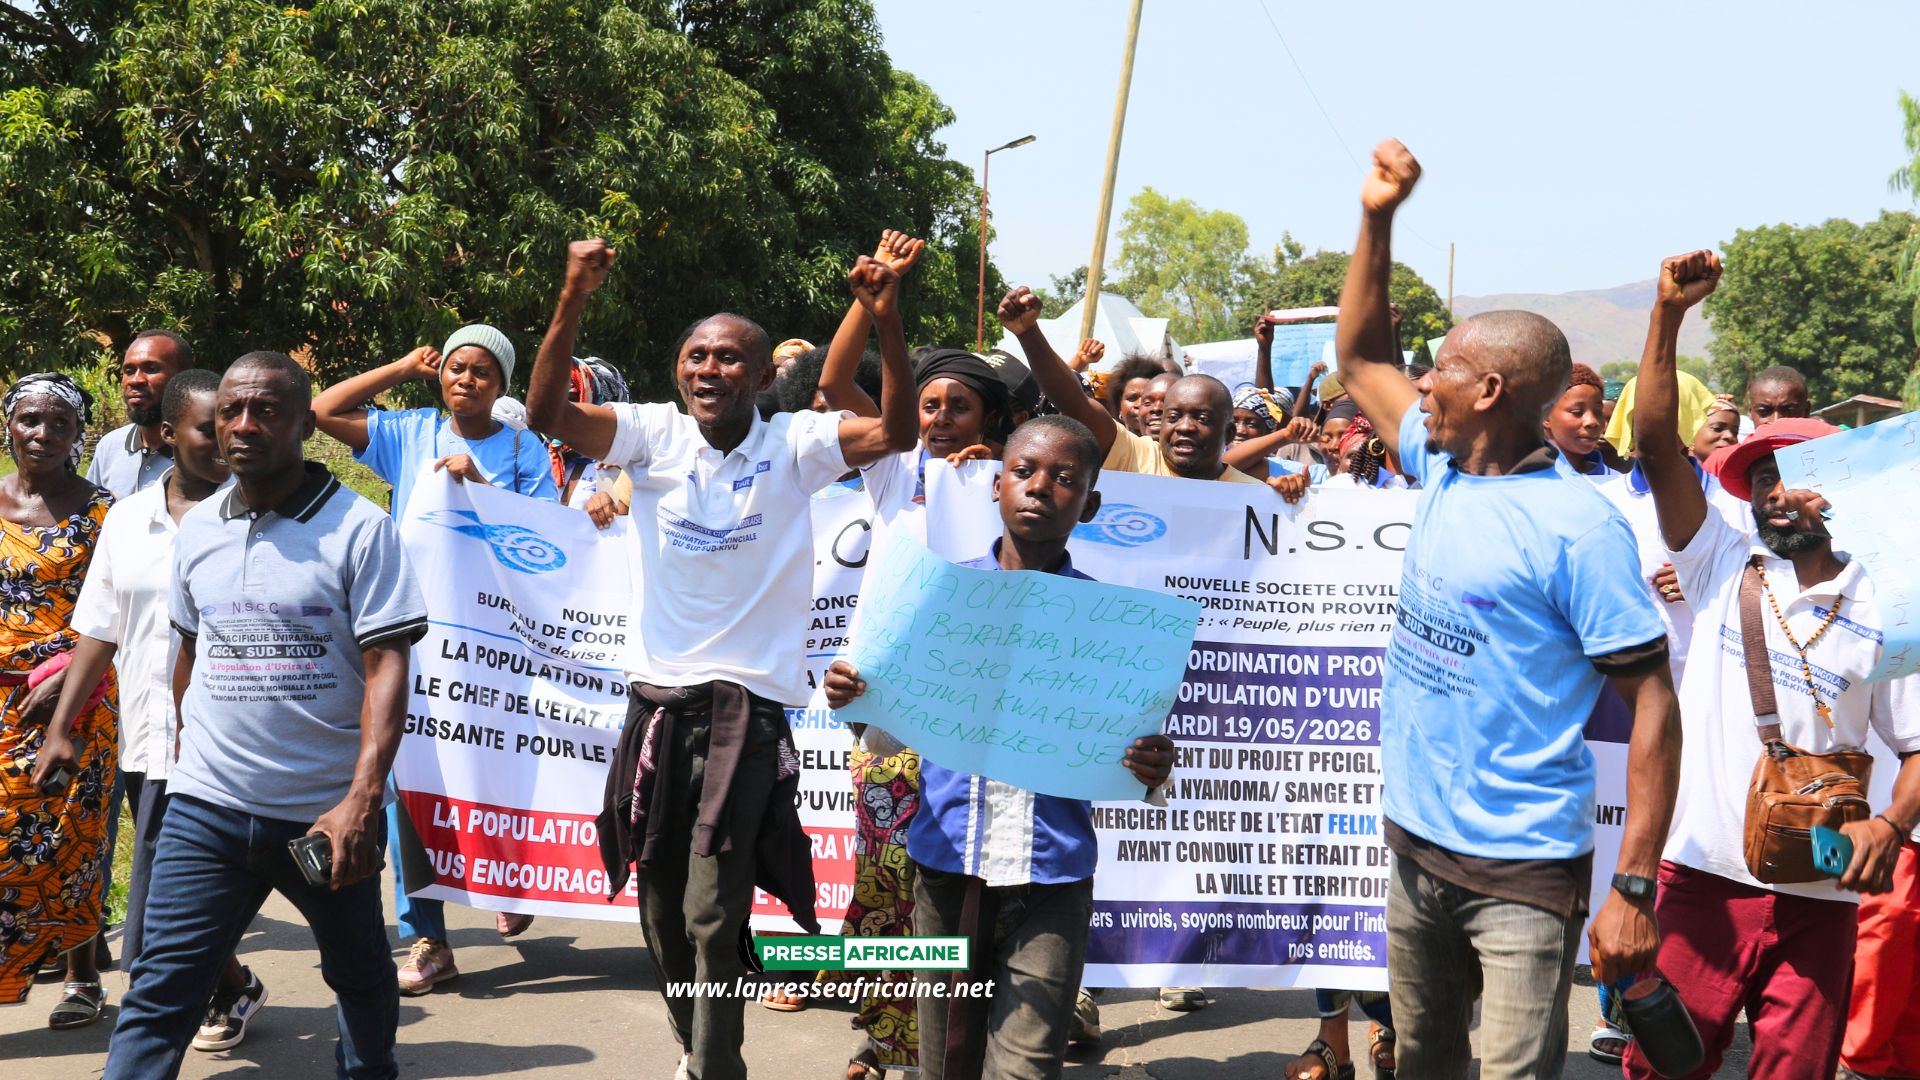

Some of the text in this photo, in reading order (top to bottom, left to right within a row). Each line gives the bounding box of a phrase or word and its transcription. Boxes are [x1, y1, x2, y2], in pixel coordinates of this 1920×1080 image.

[672, 539, 684, 547] DU
[1165, 575, 1250, 593] NOUVELLE
[1256, 582, 1336, 596] SOCIETE
[810, 594, 859, 611] ONG
[966, 576, 1075, 623] OMBA
[1177, 594, 1314, 614] ORDINATION
[477, 591, 536, 630] BUREAU
[542, 623, 566, 640] DE
[1233, 617, 1291, 633] Peuple,
[1297, 620, 1335, 633] plus
[1340, 620, 1375, 632] rien
[285, 646, 321, 657] KIVU
[509, 621, 547, 650] Notre
[551, 644, 606, 661] devise
[1430, 630, 1469, 654] KIVU
[270, 673, 280, 681] DU
[282, 673, 311, 681] PROJET
[305, 662, 318, 670] dit
[441, 639, 469, 662] LA
[475, 645, 603, 693] POPULATION
[924, 649, 1011, 680] SOKO
[1018, 665, 1098, 696] KAMA
[238, 684, 265, 692] BANQUE
[267, 684, 304, 692] MONDIALE
[414, 674, 441, 698] LE
[448, 681, 500, 708] CHEF
[504, 692, 529, 715] DE
[1224, 716, 1372, 744] 19/05/2026
[515, 733, 576, 758] POUR
[581, 743, 607, 763] LE
[1209, 748, 1233, 769] DU
[1238, 749, 1303, 771] PROJET
[1309, 752, 1381, 775] PFCIGL,
[1285, 781, 1348, 803] SANGE
[1353, 783, 1375, 804] ET
[432, 801, 600, 847] LA POPULATIO
[1172, 809, 1189, 831] LE
[1194, 810, 1236, 832] CHEF
[1241, 812, 1263, 833] DE
[1328, 813, 1378, 835] FELIX
[1117, 840, 1389, 867] AYANT CONDUIT LE RETRAIT DE
[1196, 873, 1218, 894] LA
[1220, 873, 1263, 895] VILLE
[1268, 875, 1288, 896] ET
[1121, 907, 1177, 932] uvirois,
[1181, 911, 1233, 934] soyons
[1237, 909, 1308, 931] nombreux
[1312, 913, 1350, 935] pour
[1288, 939, 1376, 961] nos entités.
